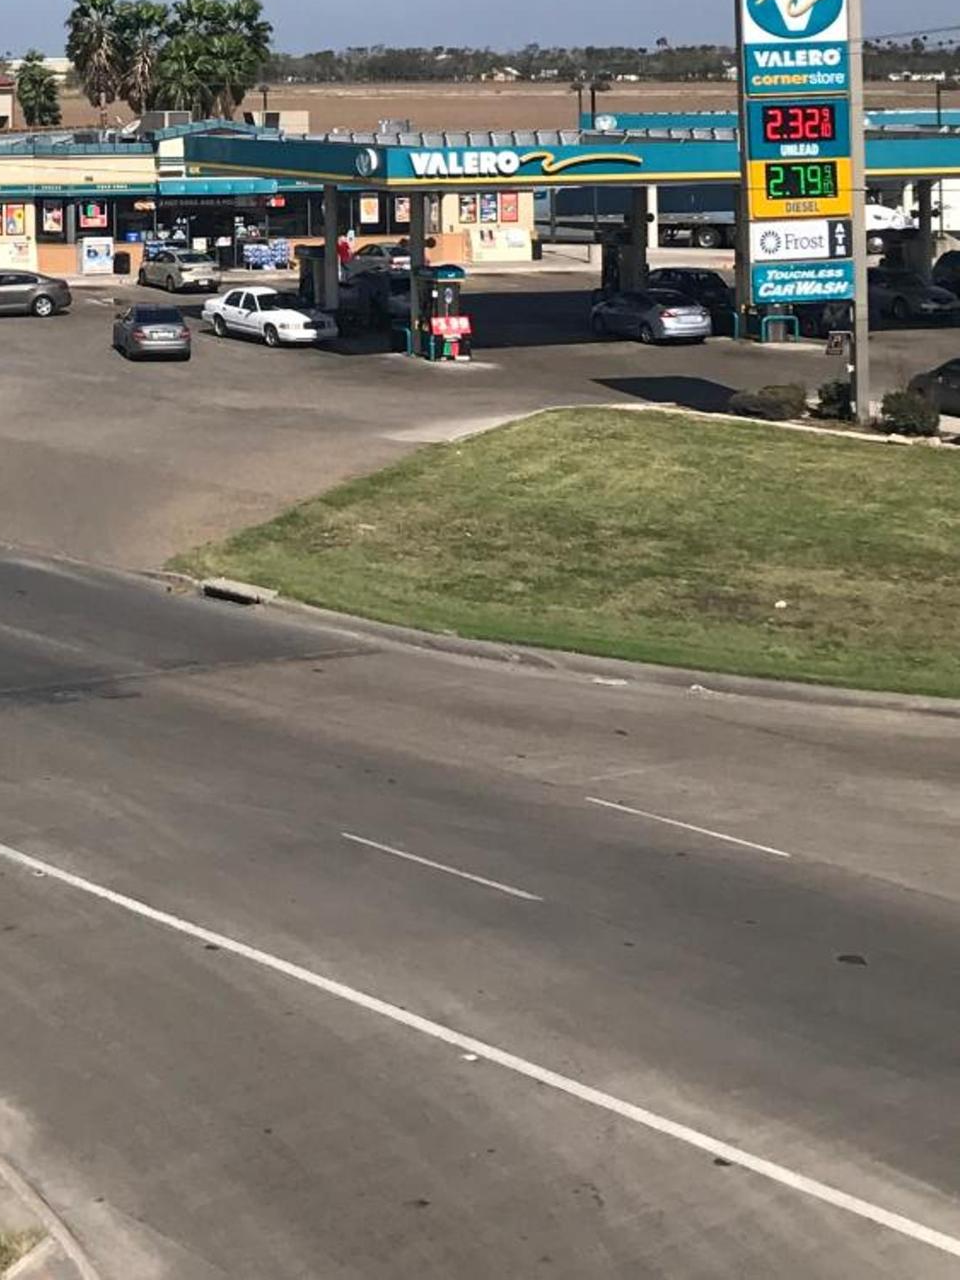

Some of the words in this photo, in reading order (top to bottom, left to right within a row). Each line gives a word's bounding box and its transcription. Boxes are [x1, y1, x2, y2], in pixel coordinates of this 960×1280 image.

[753, 49, 841, 67] VALERO
[766, 108, 819, 139] 2.32
[780, 144, 819, 156] UNLEAD
[410, 151, 520, 176] VALERO
[770, 166, 821, 196] 2.79
[785, 201, 820, 213] DIESEL
[785, 233, 824, 250] Frost
[834, 223, 846, 256] ATM
[766, 269, 844, 280] TOUCHLESS
